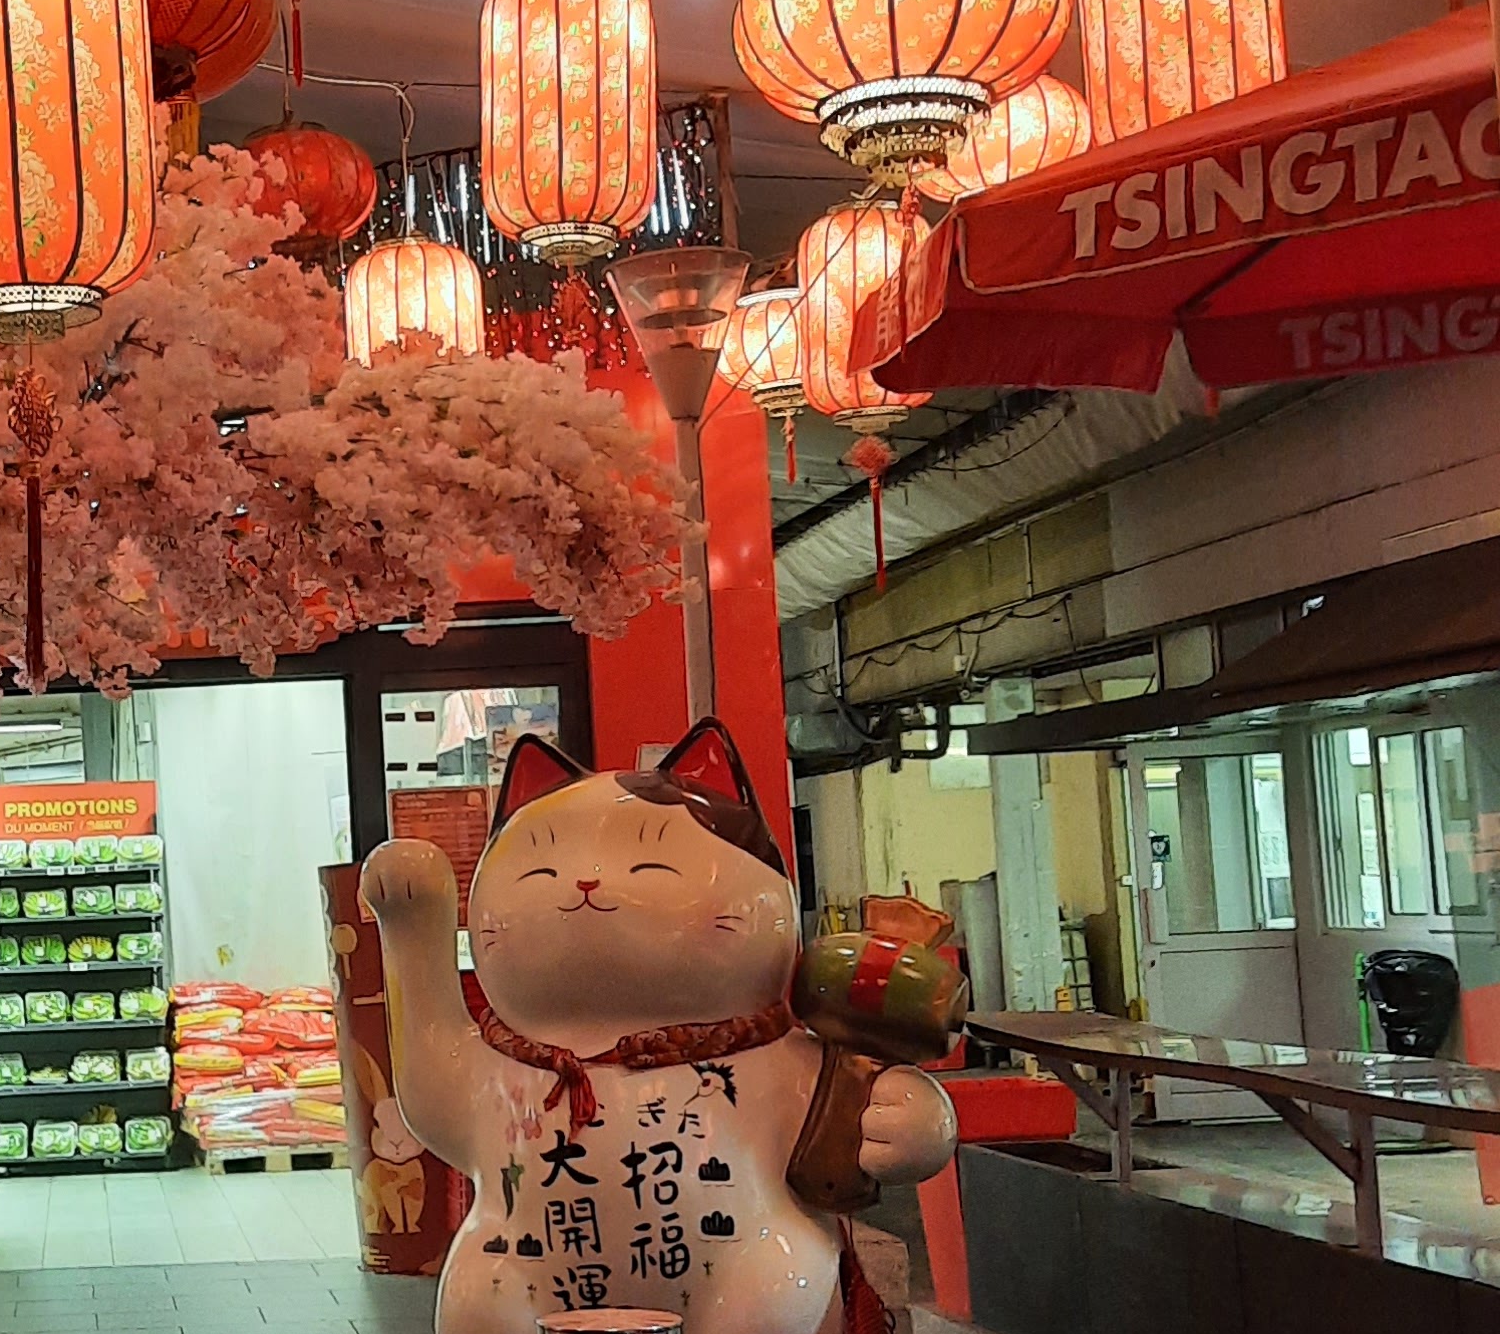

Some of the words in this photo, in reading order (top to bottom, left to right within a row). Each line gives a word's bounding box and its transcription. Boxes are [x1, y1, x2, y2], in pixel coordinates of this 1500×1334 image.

[1278, 295, 1500, 369] TSING
[4, 799, 138, 817] PROMOTIONS
[4, 823, 23, 834] DU
[24, 821, 75, 834] MOMENT
